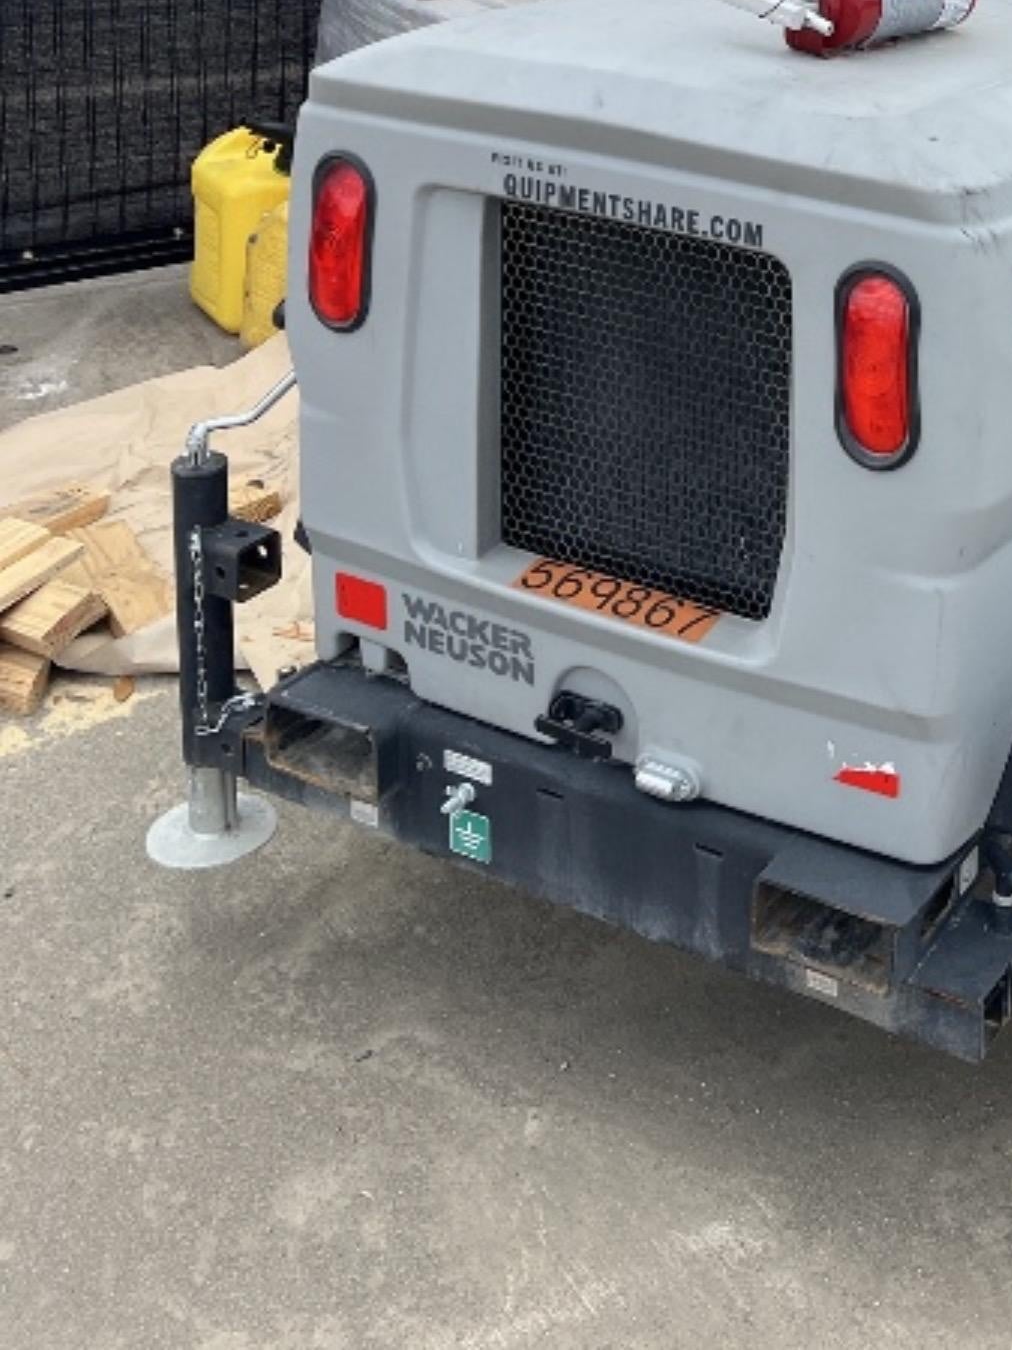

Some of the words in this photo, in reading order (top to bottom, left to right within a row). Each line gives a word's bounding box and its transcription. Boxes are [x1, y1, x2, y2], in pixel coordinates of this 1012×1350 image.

[503, 173, 763, 247] QUIPMENTSHARE.COM
[402, 593, 535, 660] WACKER
[521, 561, 720, 636] 569867
[404, 620, 535, 687] NEUSON
